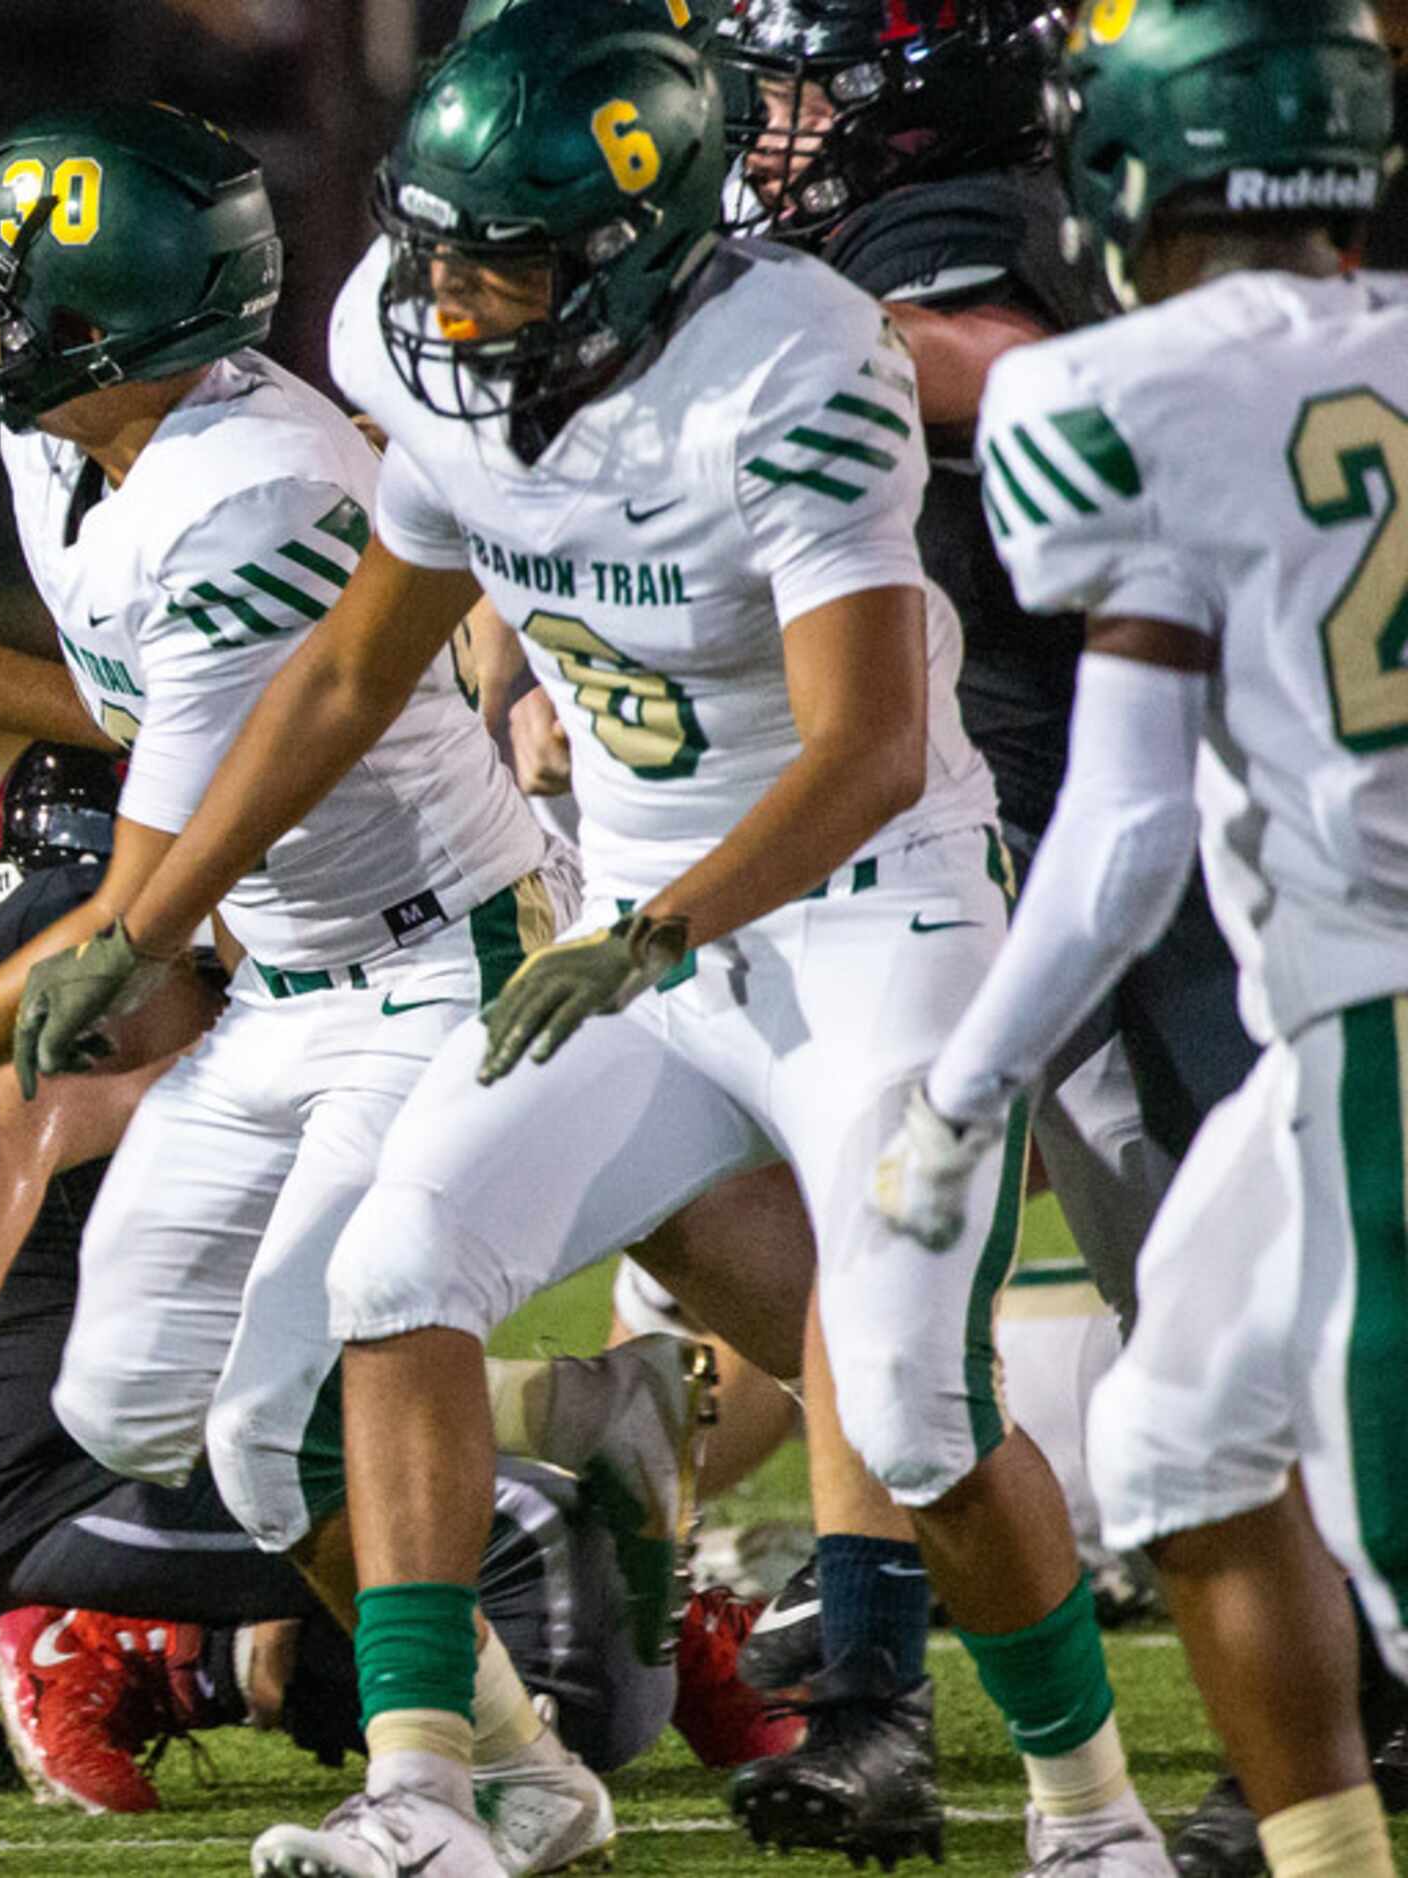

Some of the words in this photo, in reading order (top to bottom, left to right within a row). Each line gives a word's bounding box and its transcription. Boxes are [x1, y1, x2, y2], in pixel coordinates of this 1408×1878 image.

[591, 98, 661, 194] 6
[0, 156, 103, 248] 30
[1226, 167, 1377, 210] Riddell
[591, 560, 692, 607] TRAIL
